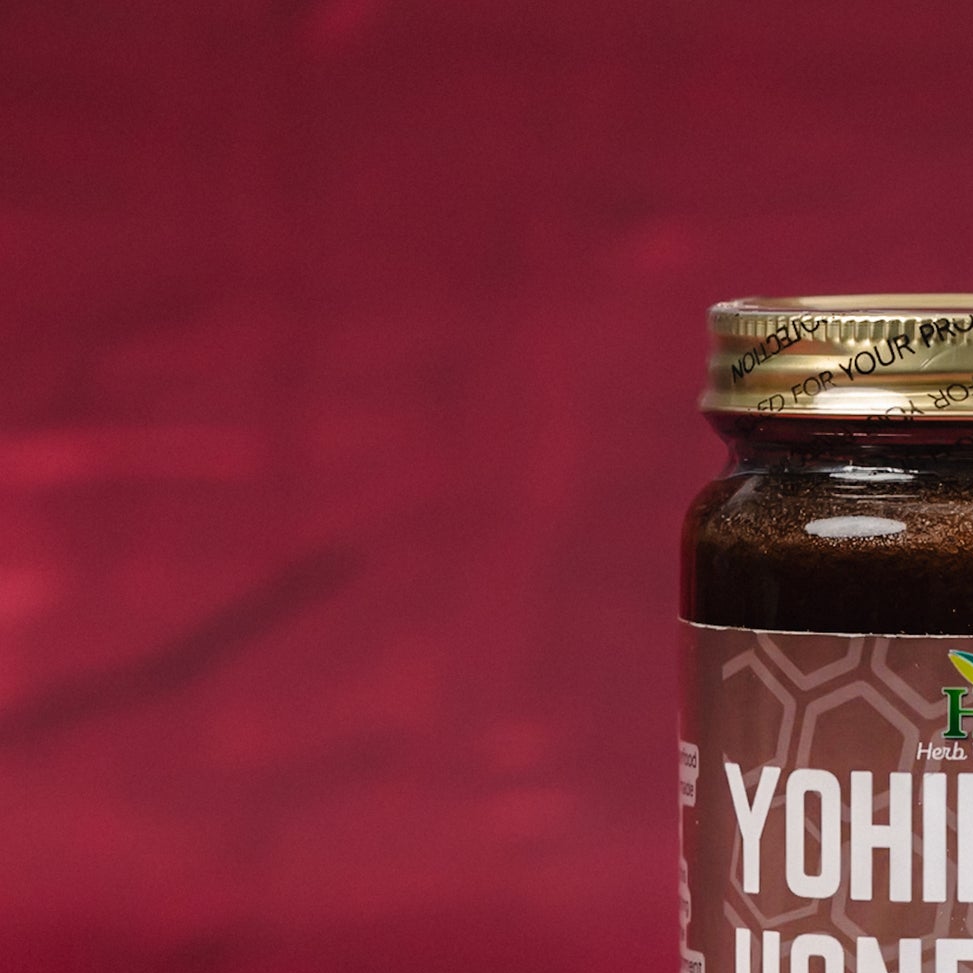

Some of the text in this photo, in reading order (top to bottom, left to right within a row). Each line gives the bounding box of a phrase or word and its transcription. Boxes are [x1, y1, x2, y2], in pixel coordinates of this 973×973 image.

[791, 370, 837, 403] FOR
[839, 334, 916, 380] YOUR
[916, 741, 968, 761] Herb
